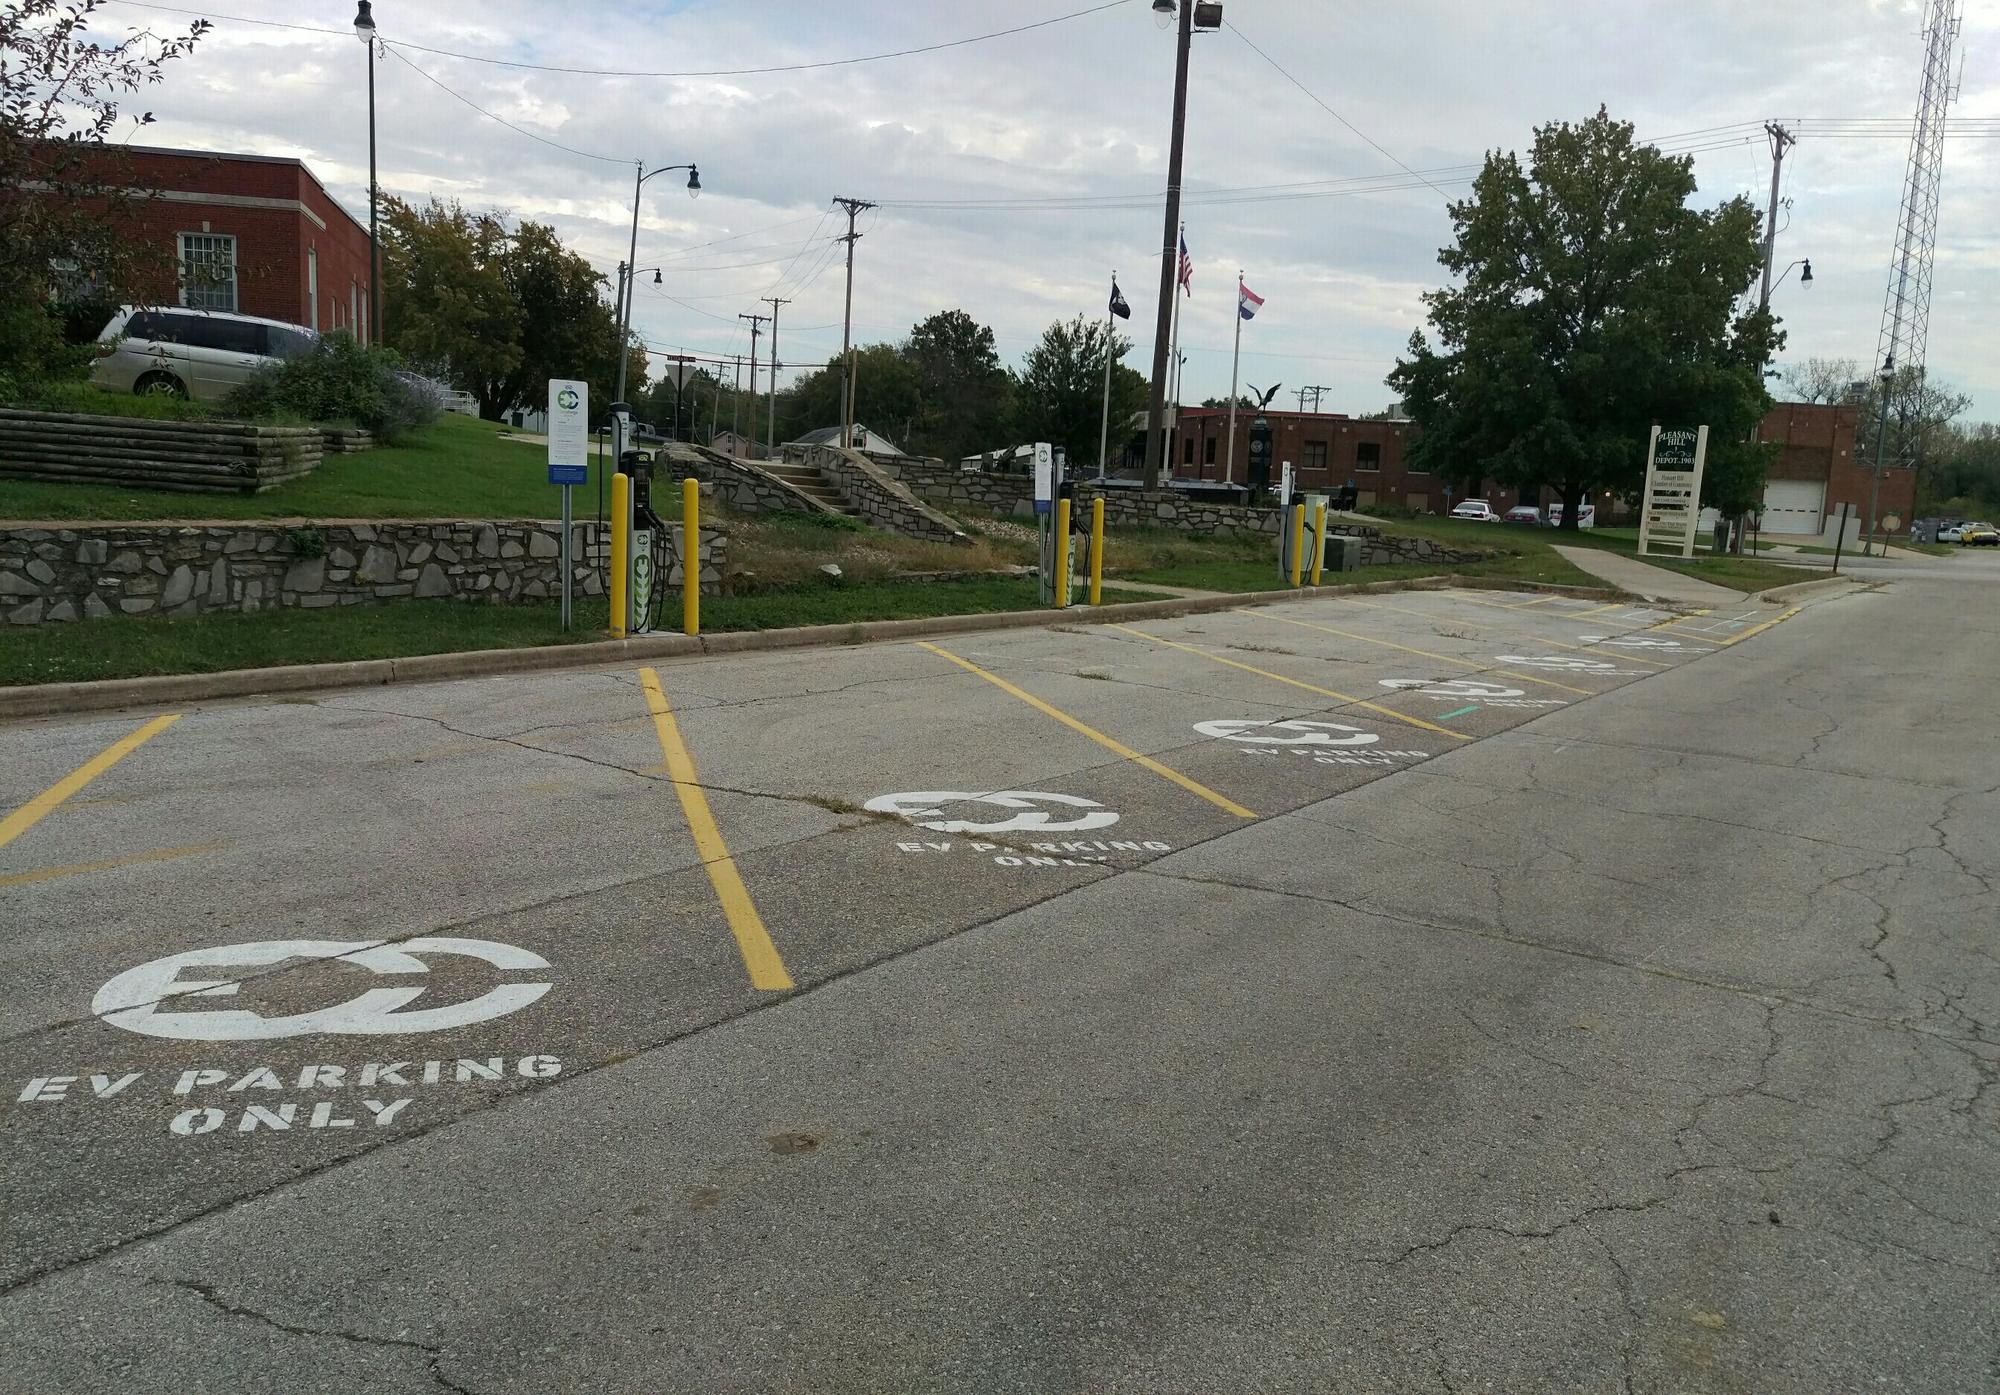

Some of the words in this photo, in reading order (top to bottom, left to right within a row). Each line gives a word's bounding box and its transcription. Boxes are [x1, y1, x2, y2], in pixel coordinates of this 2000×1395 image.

[1658, 430, 1697, 442] PLEASANT
[1667, 438, 1686, 446] HILL
[1290, 749, 1430, 758] PARKING
[1313, 757, 1392, 765] ONLY
[896, 842, 951, 852] EV
[971, 840, 1171, 853] PRKING
[17, 1072, 144, 1101] EV
[172, 1054, 562, 1094] PARKING
[170, 1098, 415, 1135] ONLY
